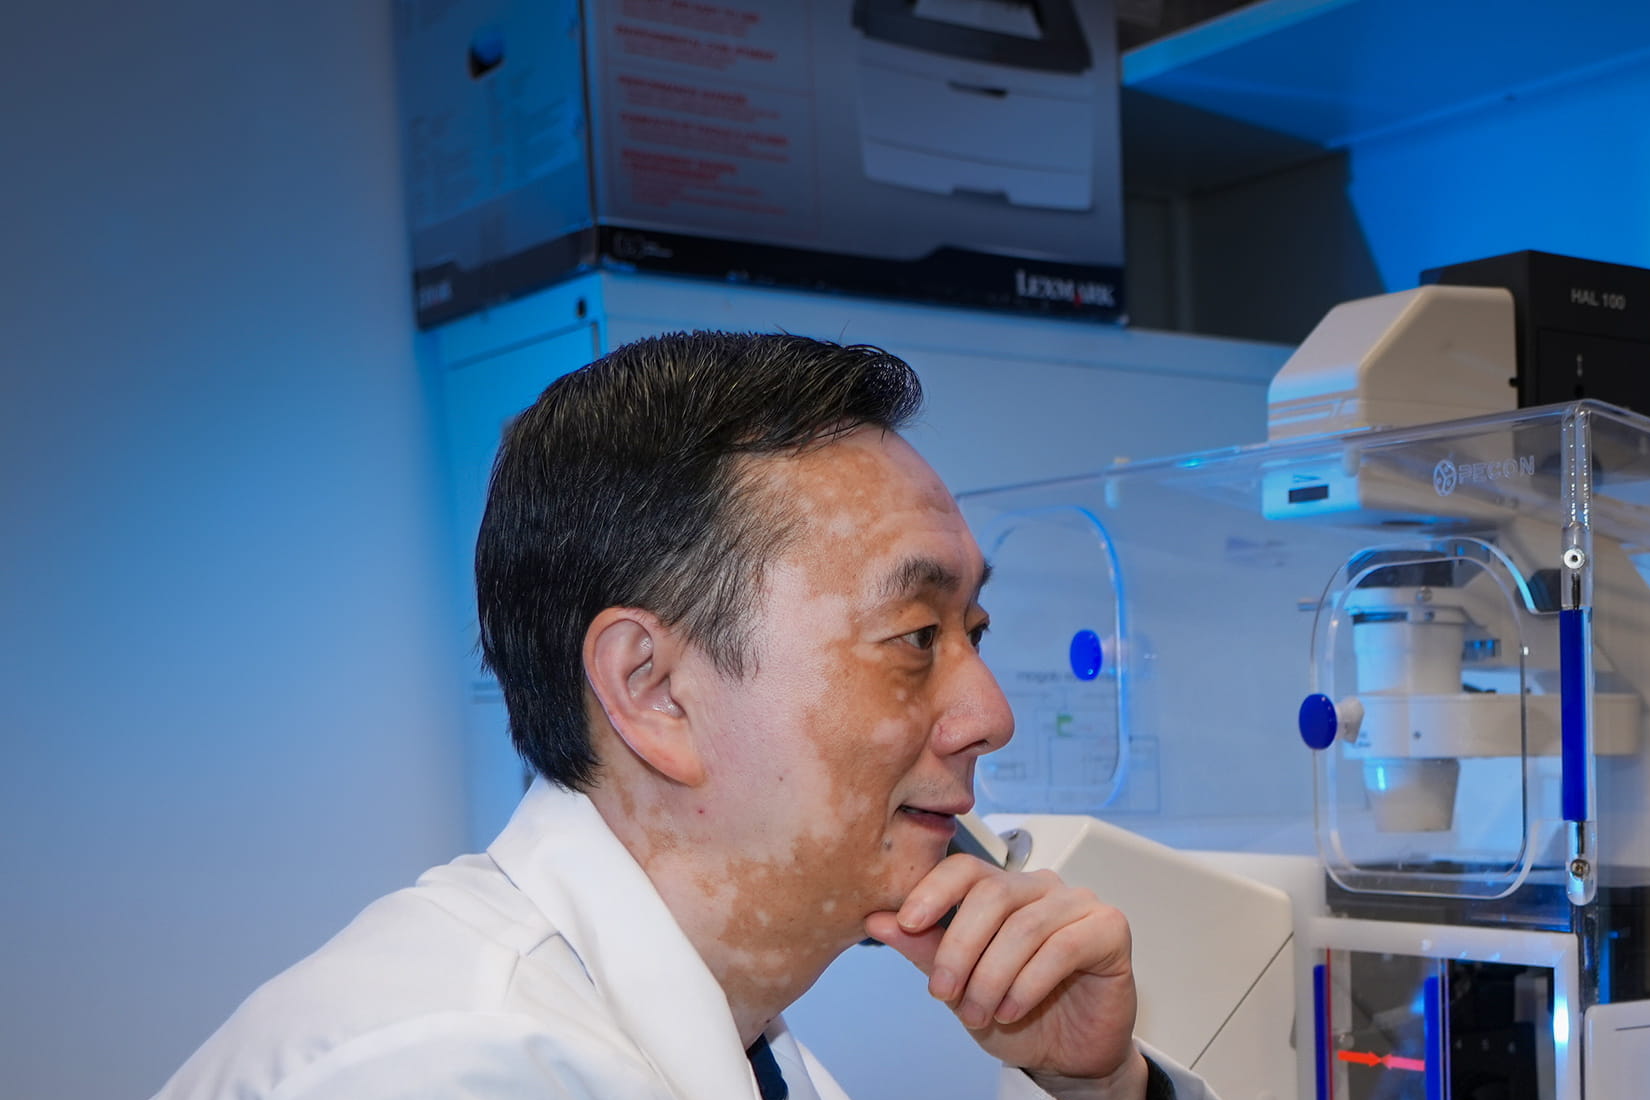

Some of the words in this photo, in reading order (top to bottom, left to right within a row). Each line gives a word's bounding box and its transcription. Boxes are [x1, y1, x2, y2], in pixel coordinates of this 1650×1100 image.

[1571, 288, 1599, 306] HAL
[1602, 293, 1626, 310] 100
[1459, 456, 1535, 485] PECON
